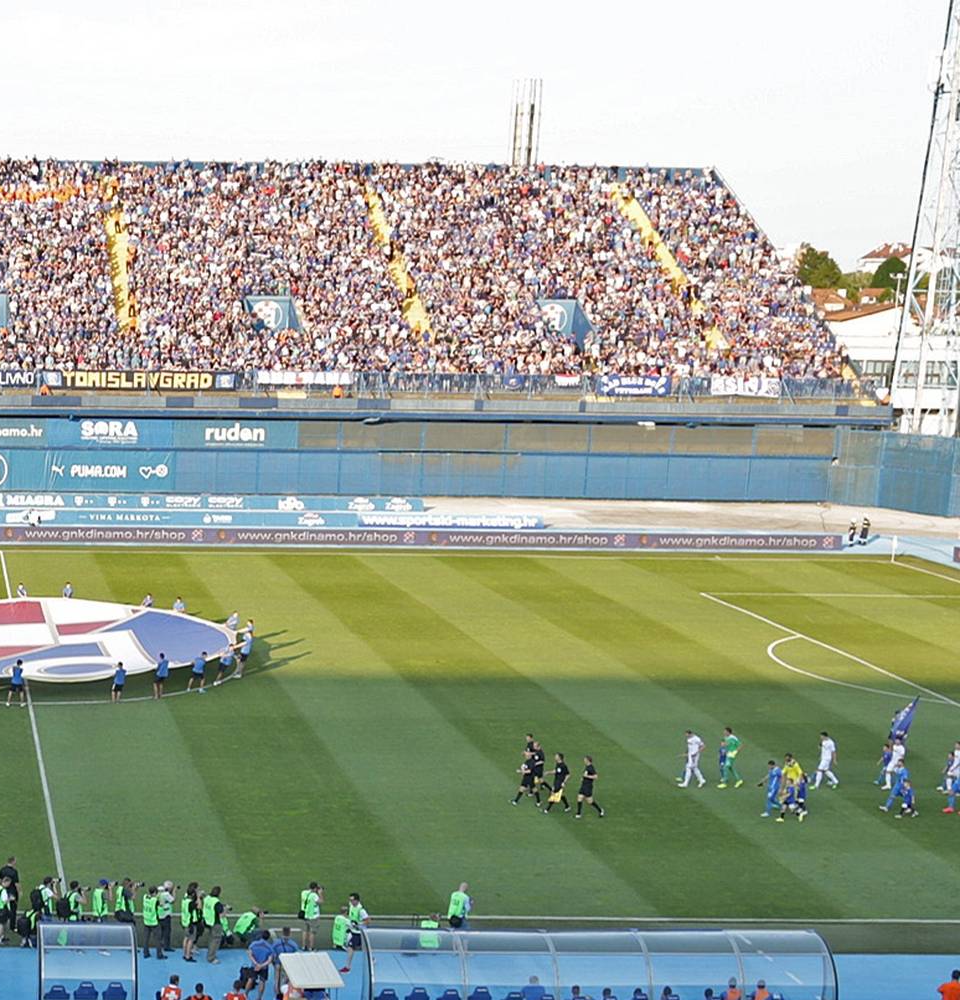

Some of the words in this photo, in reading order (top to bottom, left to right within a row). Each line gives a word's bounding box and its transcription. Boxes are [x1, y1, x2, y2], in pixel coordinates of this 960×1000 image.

[63, 371, 213, 389] TOMISLAVGRAD
[70, 464, 127, 478] PUMA.COM
[25, 528, 186, 540] www.gnkdinamo.hr/shop
[237, 530, 398, 542] www.gnkdinamo.hr/shop
[449, 531, 608, 544] www.gnkdinamo.hr/shop
[659, 534, 817, 548] www.gnkdinamo.hr/shop
